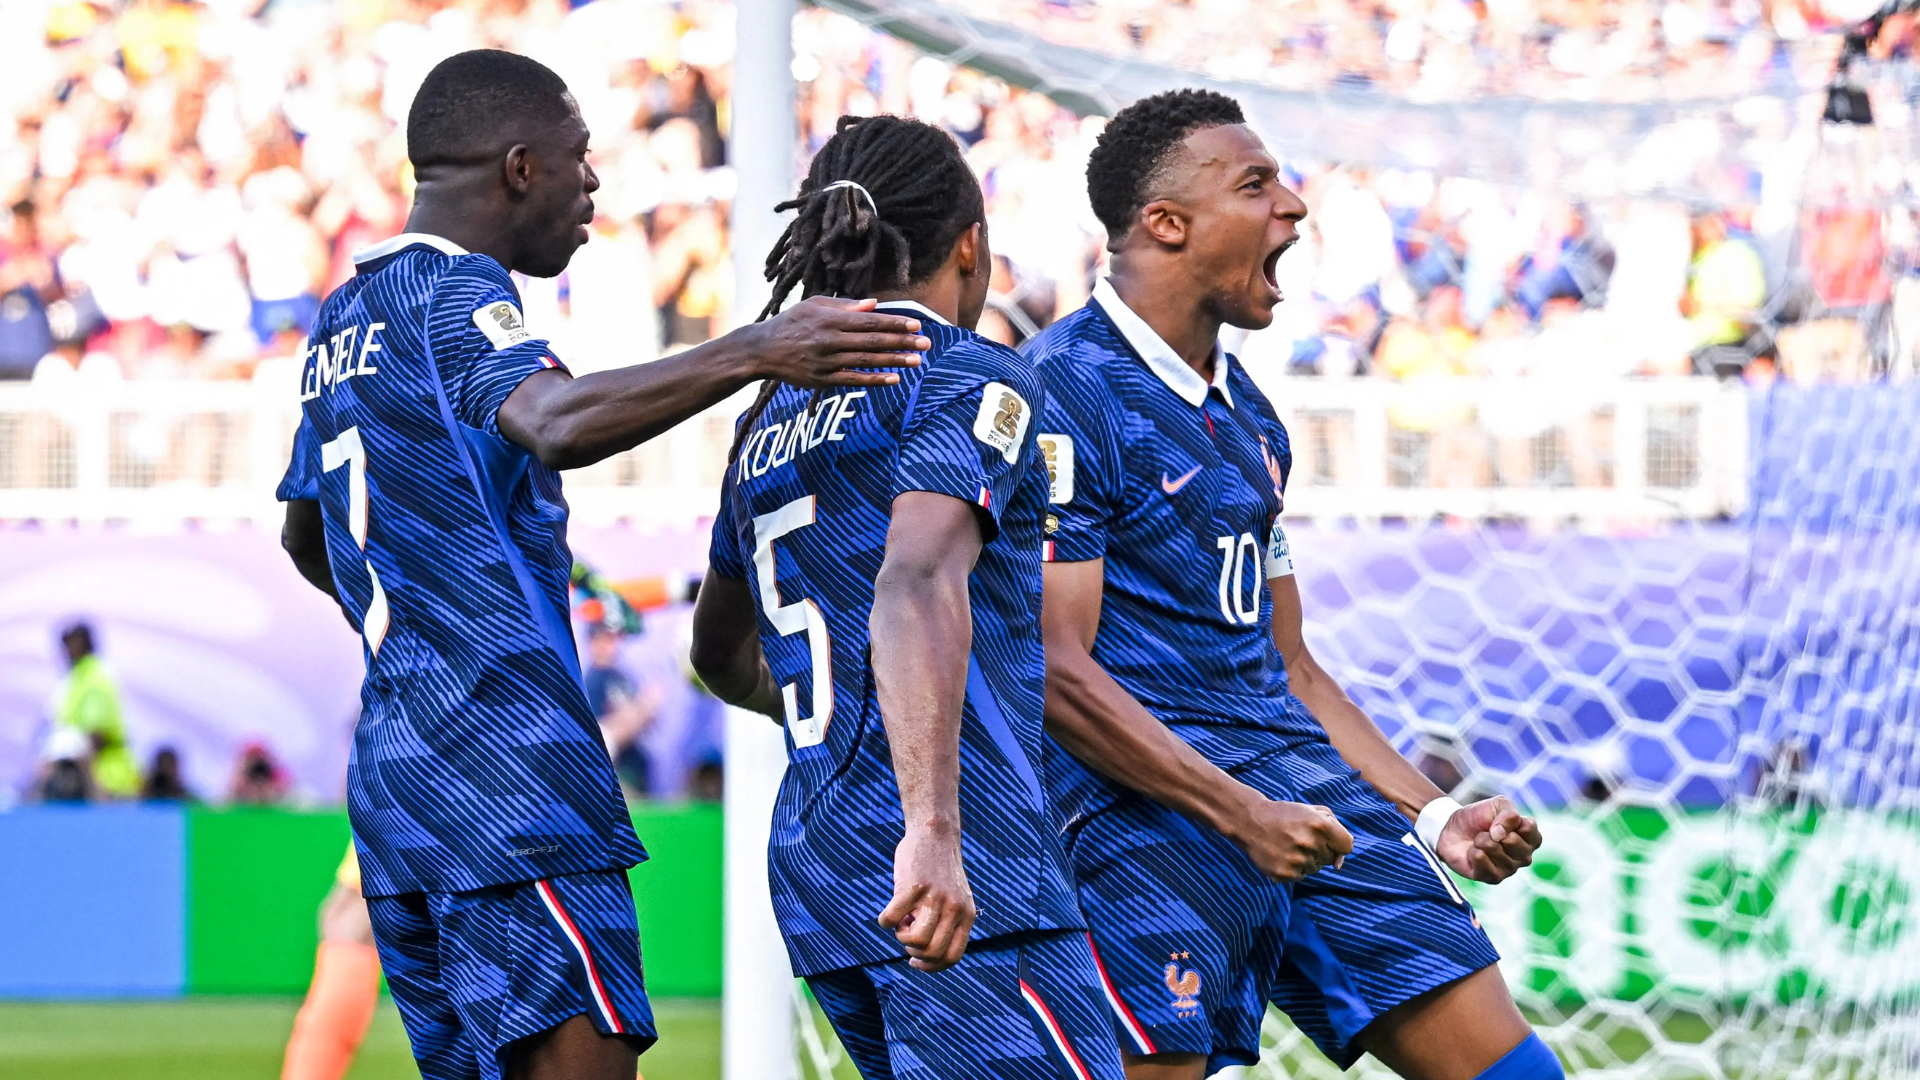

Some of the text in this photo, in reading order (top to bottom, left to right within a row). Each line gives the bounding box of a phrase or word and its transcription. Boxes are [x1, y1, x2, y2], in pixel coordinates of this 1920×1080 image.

[736, 390, 868, 486] KOUNDE
[320, 425, 390, 659] 7
[1217, 531, 1262, 625] 10
[752, 494, 835, 749] 5
[506, 845, 559, 857] AERO-FIT
